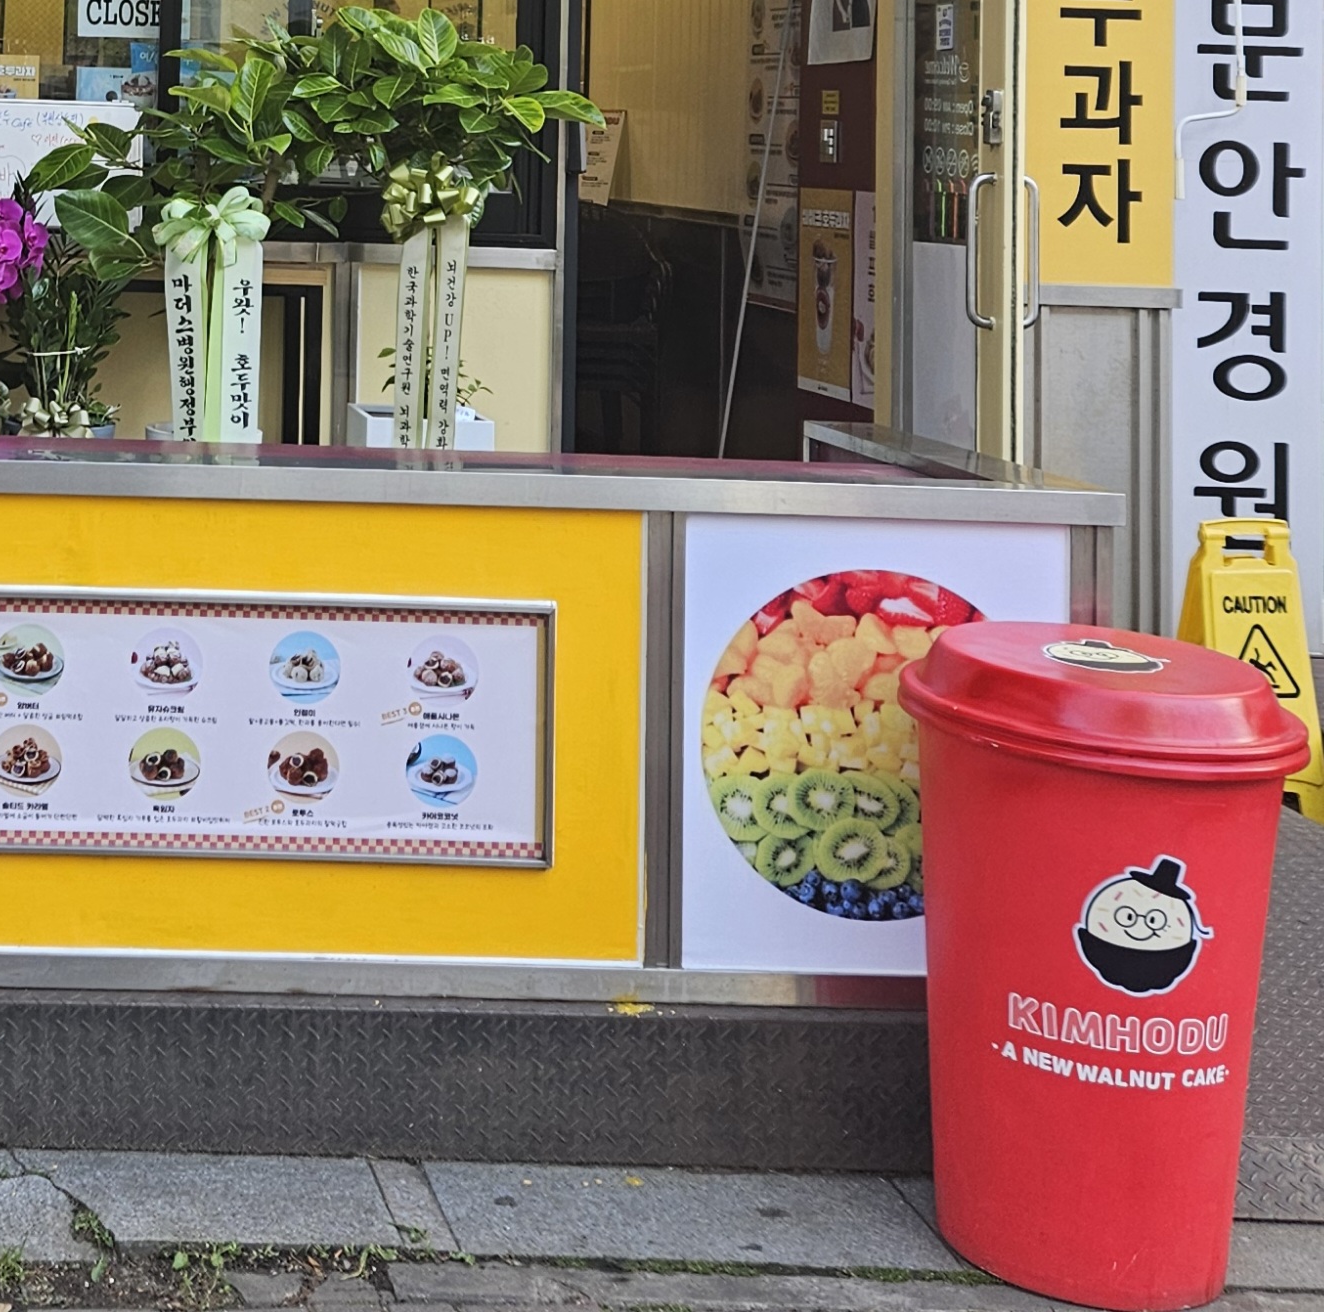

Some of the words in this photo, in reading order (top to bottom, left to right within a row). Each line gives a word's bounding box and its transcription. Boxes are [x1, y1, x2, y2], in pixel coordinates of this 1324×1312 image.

[1222, 595, 1287, 615] CAUTION
[1008, 991, 1229, 1055] KIMHODU
[1022, 1046, 1073, 1077] NEW
[1075, 1062, 1176, 1090] WALNUT
